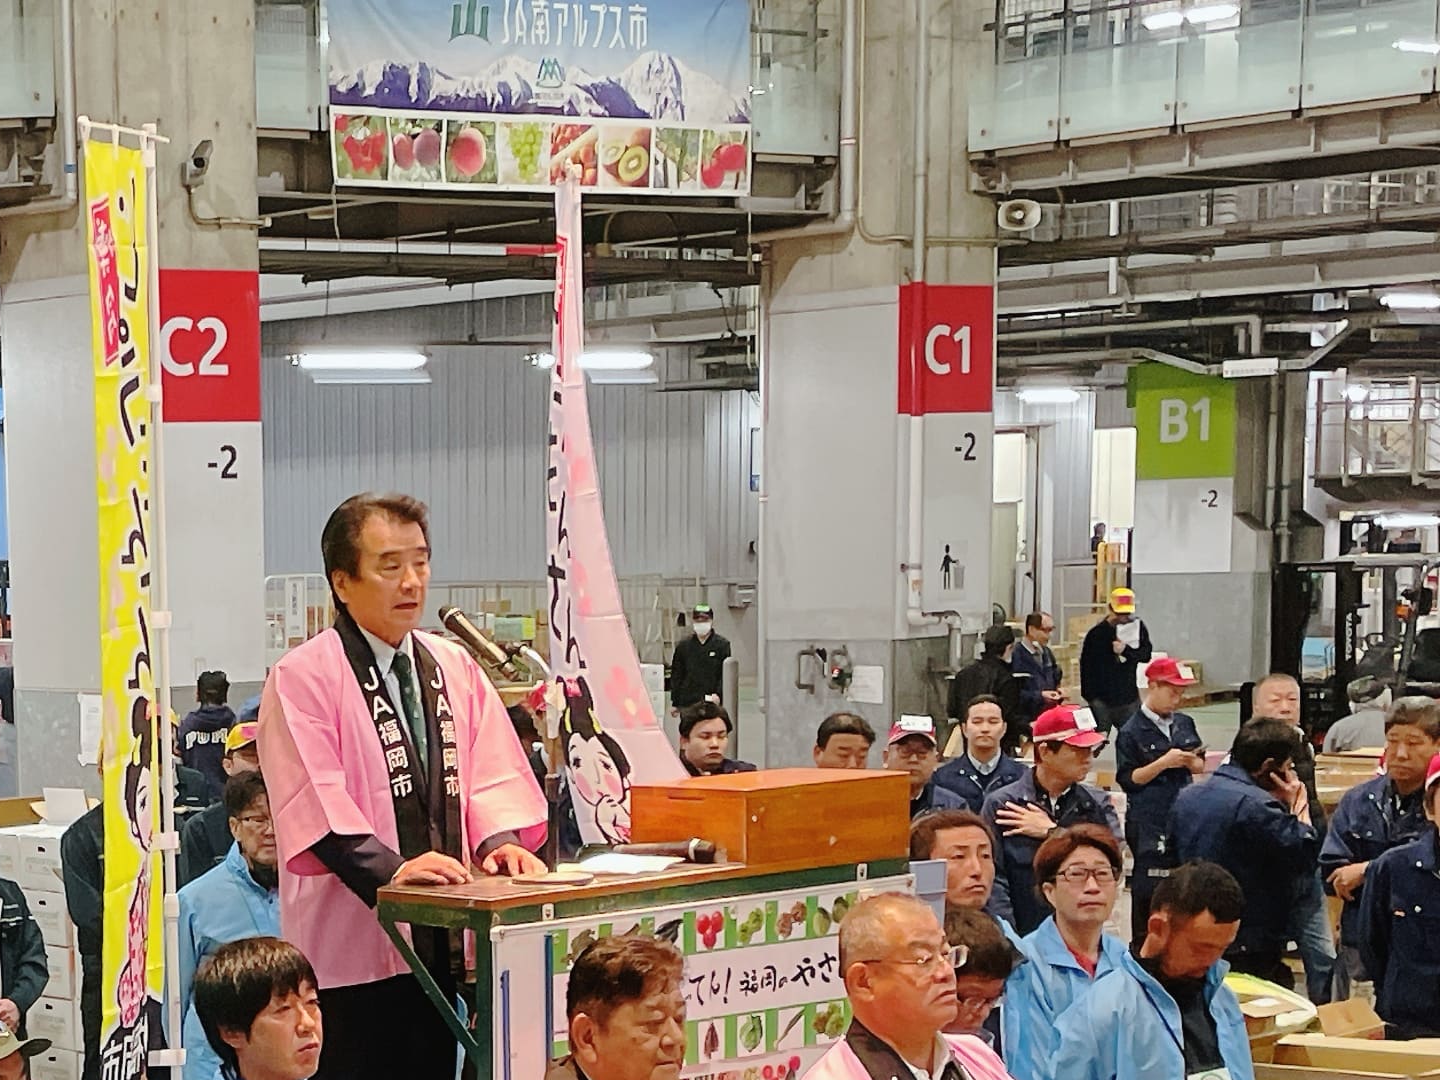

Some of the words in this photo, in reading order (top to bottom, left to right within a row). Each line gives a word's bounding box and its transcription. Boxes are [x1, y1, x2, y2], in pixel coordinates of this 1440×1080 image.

[499, 0, 649, 51] JA南アルプス市
[161, 316, 229, 376] C2
[924, 324, 971, 375] C1
[1160, 397, 1210, 443] B1
[207, 444, 239, 479] -2
[954, 432, 977, 461] -2
[1201, 490, 1218, 508] -2
[185, 728, 228, 750] PUM
[364, 665, 413, 798] JA福岡市
[430, 665, 460, 798] JA福岡市
